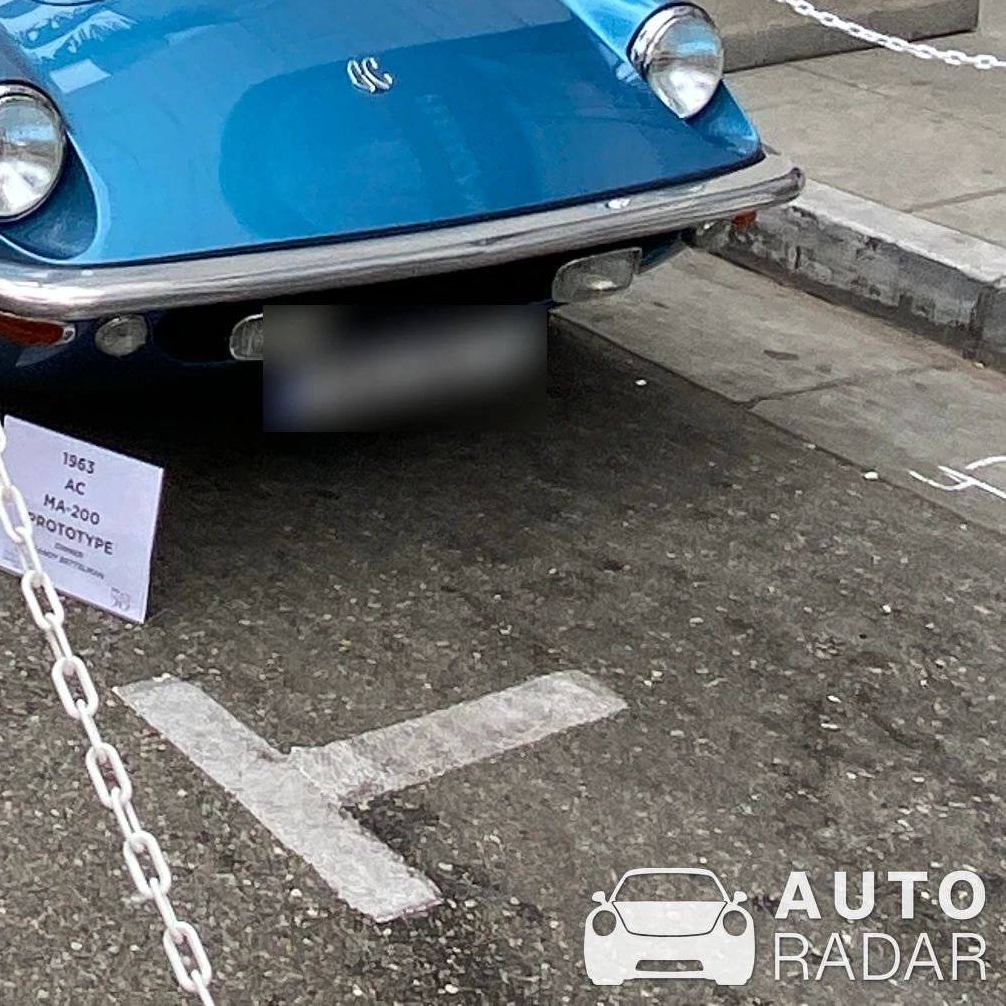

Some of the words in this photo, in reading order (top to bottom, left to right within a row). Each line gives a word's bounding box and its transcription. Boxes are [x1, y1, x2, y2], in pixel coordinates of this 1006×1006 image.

[62, 451, 96, 474] 1963
[64, 478, 87, 496] AC
[43, 494, 100, 525] MA-200
[28, 511, 114, 556] PROTOTYPE
